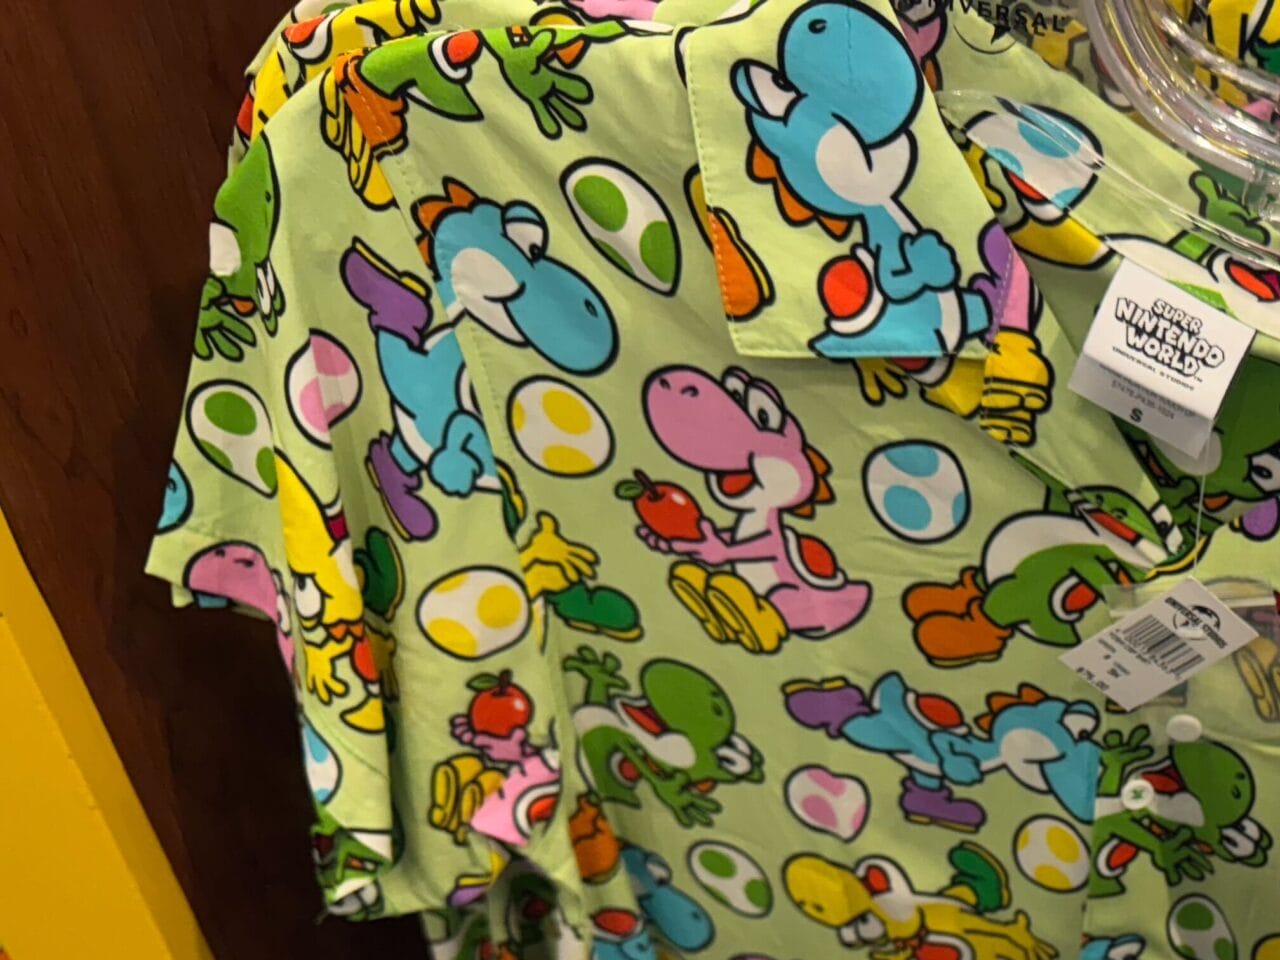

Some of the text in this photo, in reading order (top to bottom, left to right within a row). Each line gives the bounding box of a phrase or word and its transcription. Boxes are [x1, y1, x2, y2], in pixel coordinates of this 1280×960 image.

[1115, 297, 1225, 369] NINTENDO
[1151, 299, 1204, 336] SUPER
[1125, 325, 1201, 378] WORLD
[1130, 407, 1144, 424] S
